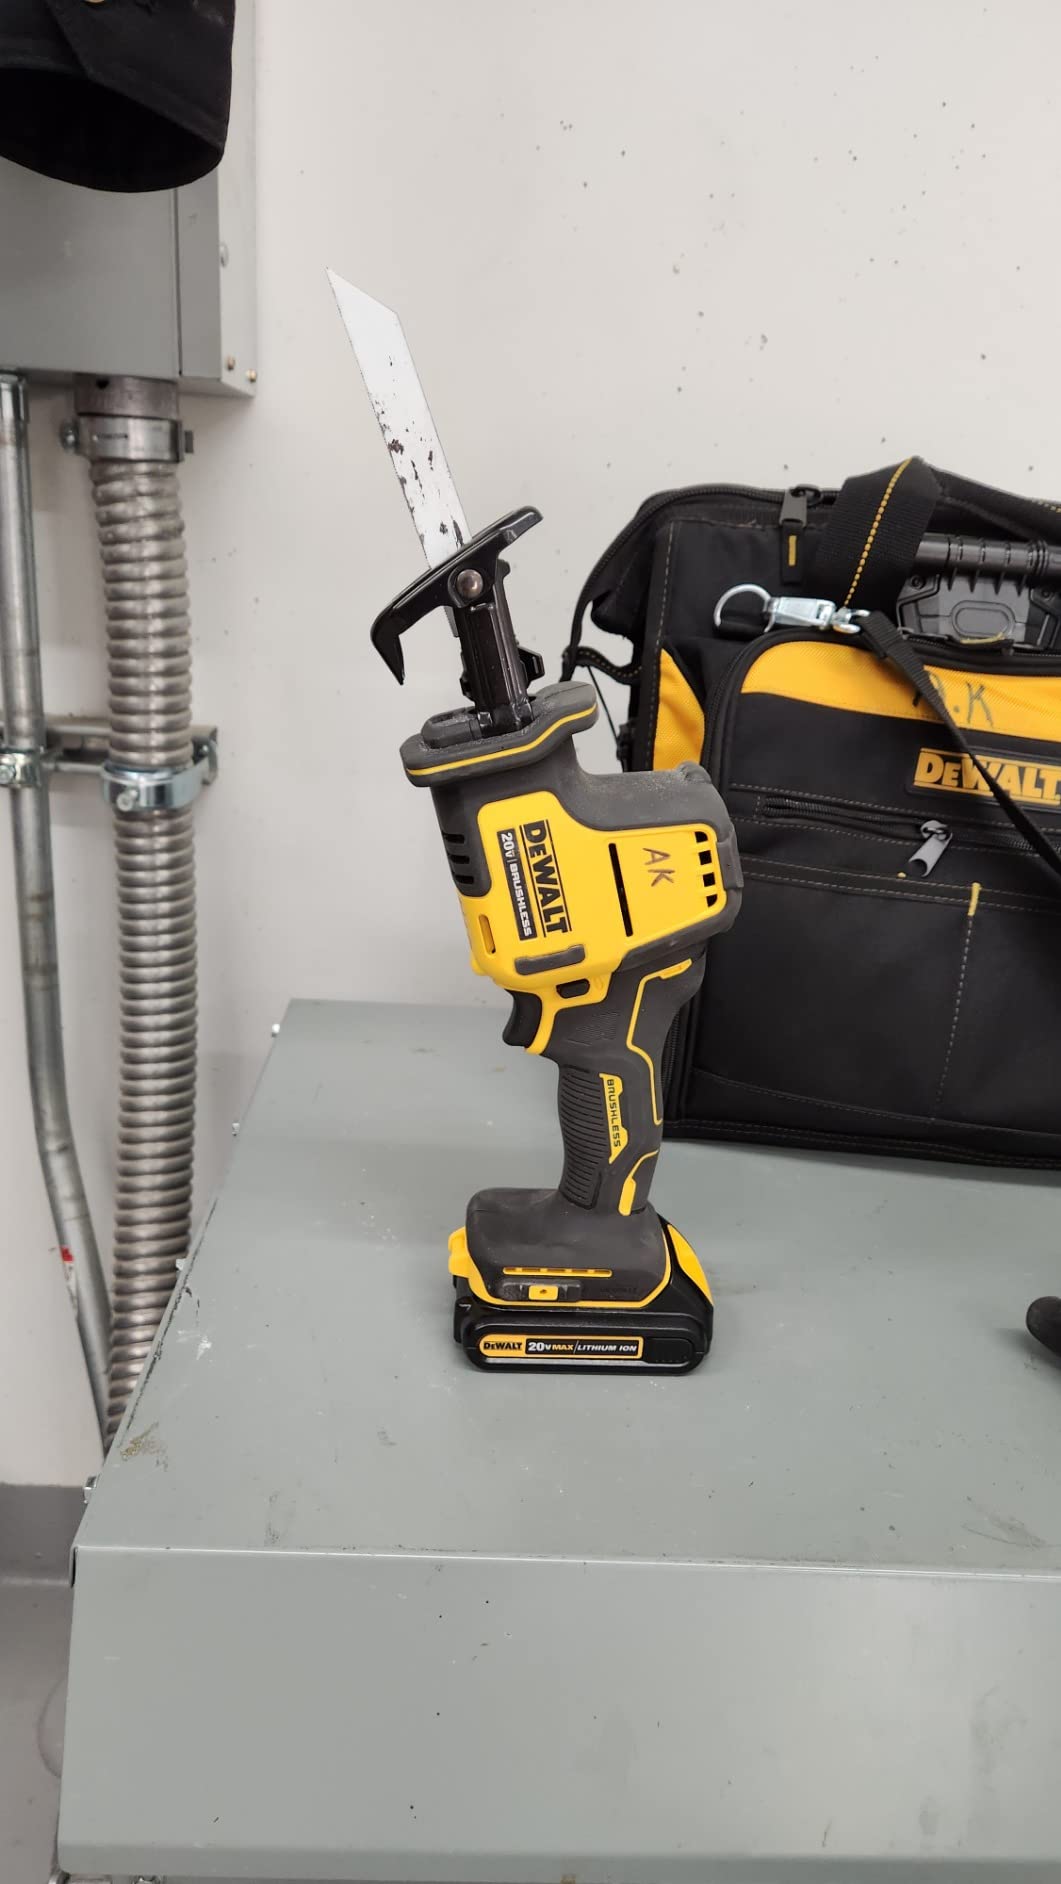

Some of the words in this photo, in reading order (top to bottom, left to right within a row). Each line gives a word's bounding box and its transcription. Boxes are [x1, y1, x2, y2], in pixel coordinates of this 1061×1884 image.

[523, 820, 568, 933] DEWALT
[641, 847, 676, 887] AK
[509, 863, 532, 937] BRUSHLESS
[606, 1079, 621, 1148] BRUSHLESS
[483, 1340, 523, 1351] DEWALT
[619, 1344, 638, 1352] ION
